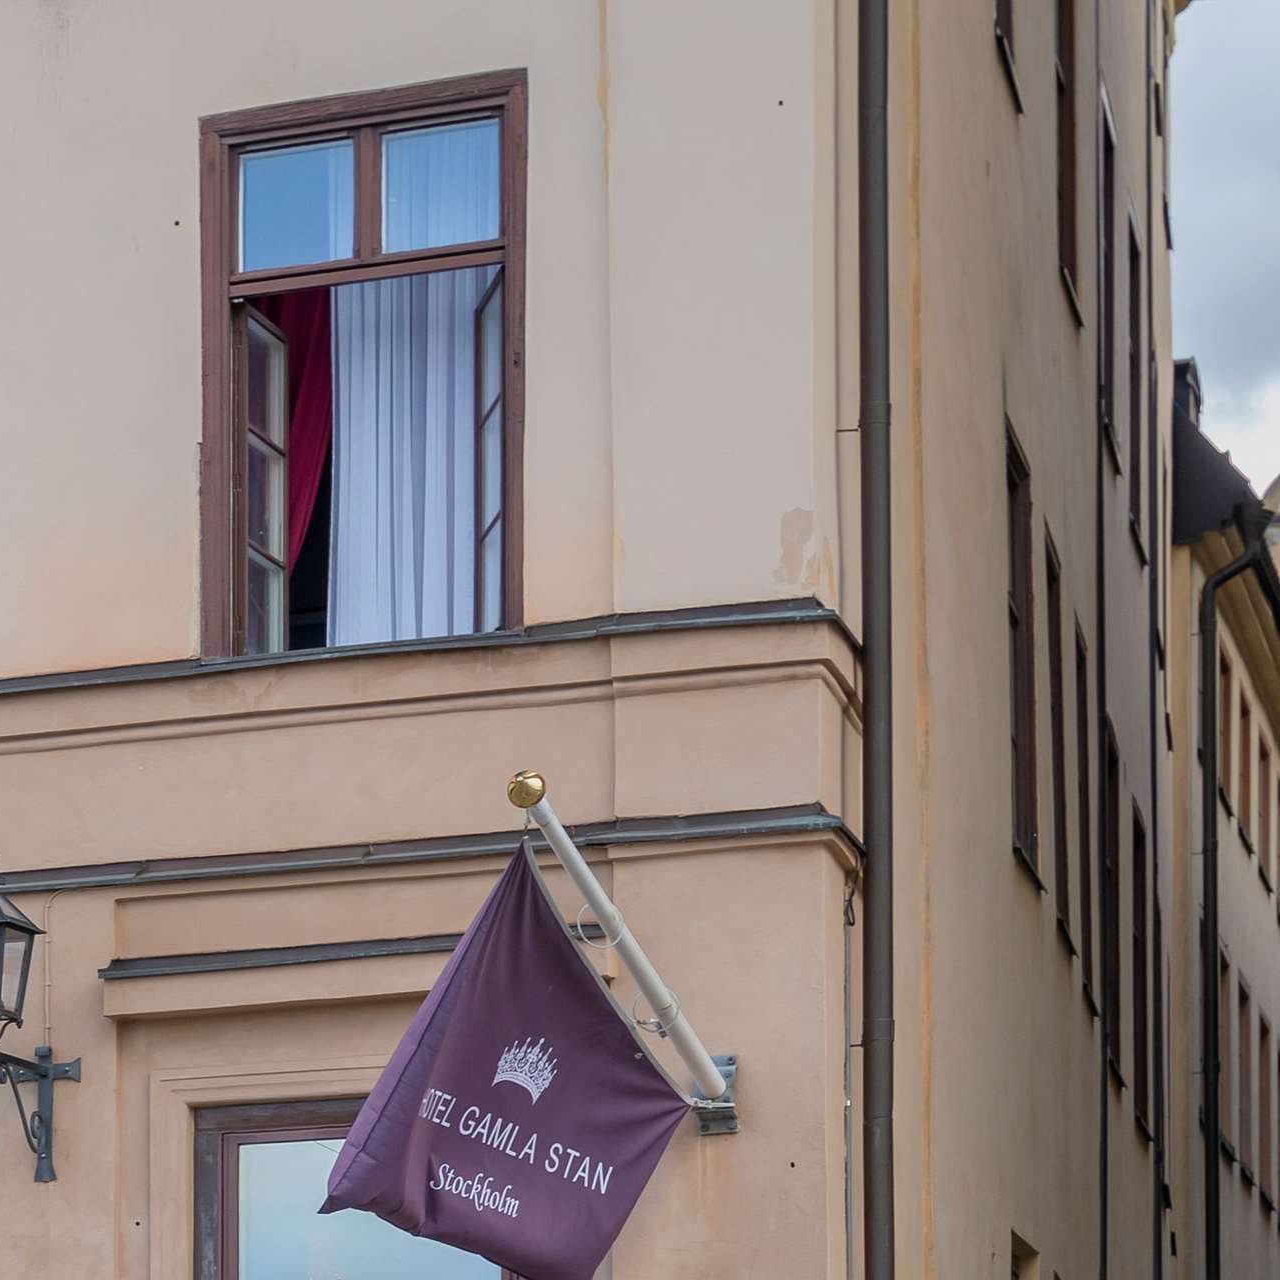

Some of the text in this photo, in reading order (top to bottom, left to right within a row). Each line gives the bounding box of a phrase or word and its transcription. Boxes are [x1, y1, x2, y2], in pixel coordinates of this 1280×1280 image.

[459, 1106, 537, 1164] GAMLA
[545, 1143, 614, 1194] STAN
[430, 1163, 520, 1218] Stockholm
